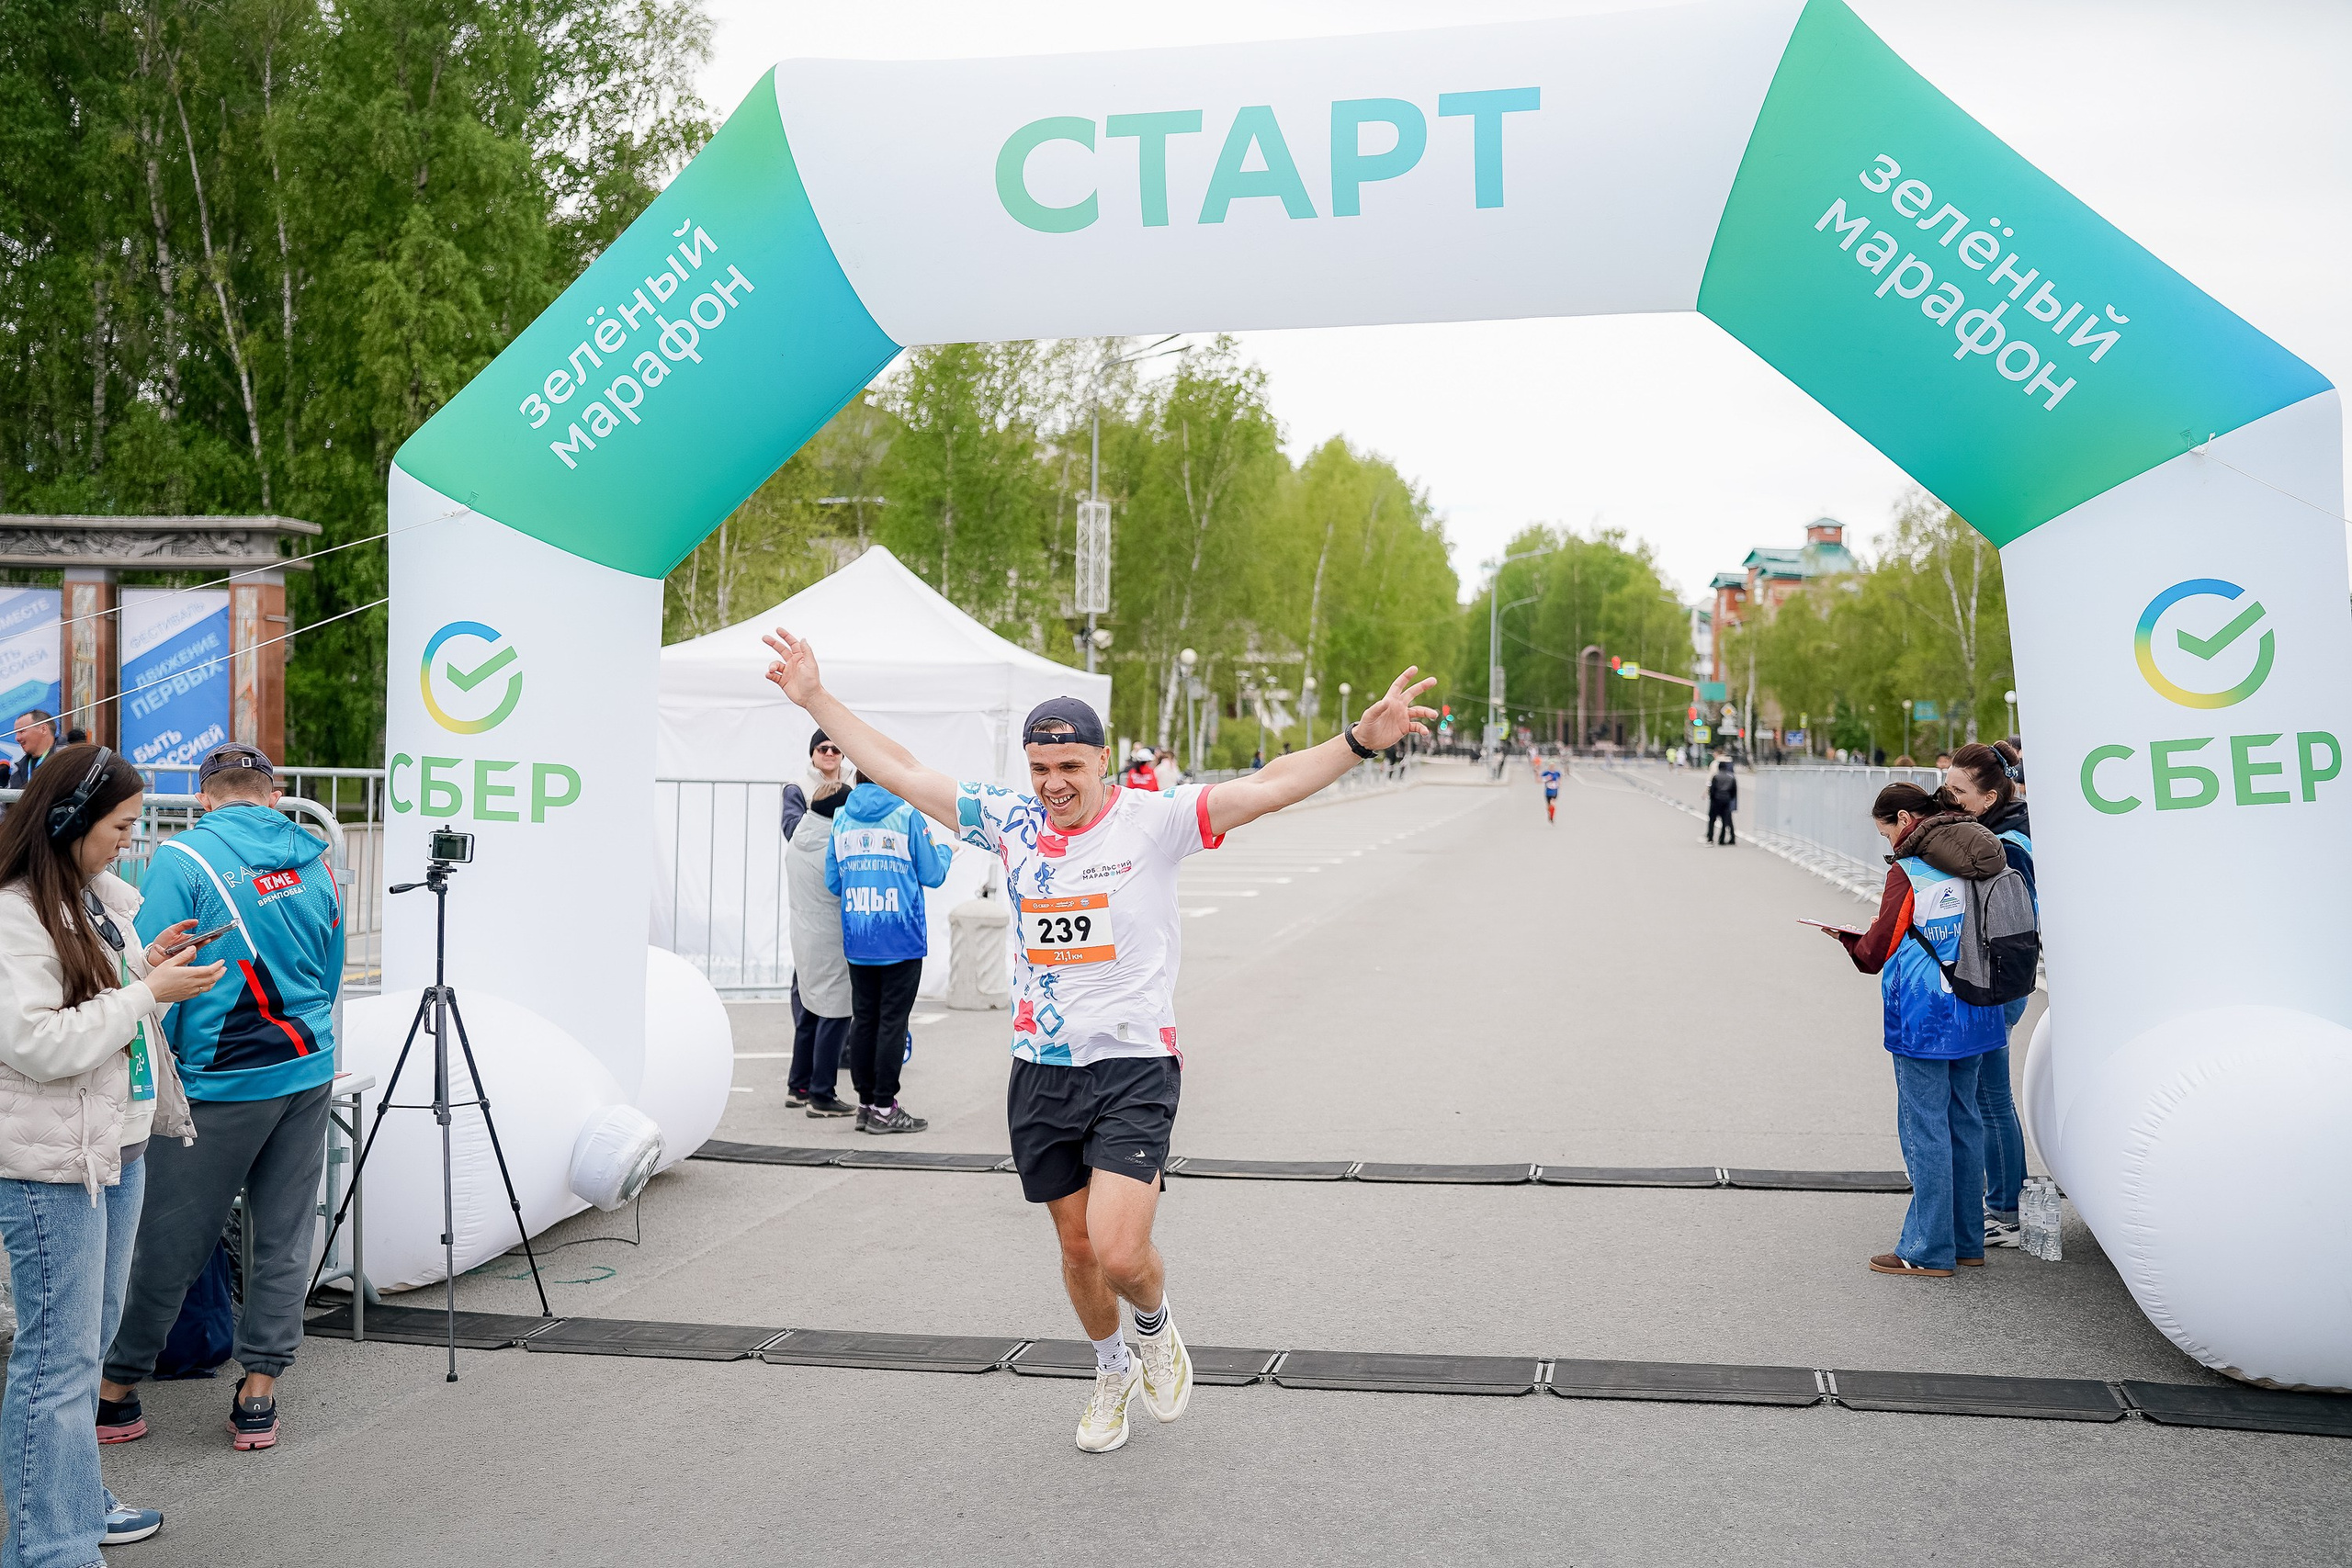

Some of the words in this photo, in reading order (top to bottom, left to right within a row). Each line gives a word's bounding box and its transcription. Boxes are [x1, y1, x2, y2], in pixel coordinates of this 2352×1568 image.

[995, 86, 1541, 233] СТАРТ
[1858, 152, 2131, 364] зелёный
[518, 218, 718, 430] зелёный
[1814, 197, 2078, 412] марафон
[548, 263, 756, 470] марафон
[129, 601, 205, 649] ФЕСТИВАЛЬ
[130, 653, 225, 720] ПЕРВЫХ
[134, 631, 221, 692] ДВИЖЕНИЕ
[132, 728, 183, 764] БЫТЬ
[153, 722, 226, 774] ОССИЕЙ
[2080, 731, 2343, 815] СБЕР
[390, 753, 582, 823] СБЕР
[845, 886, 899, 916] СУДЬЯ
[1082, 870, 1121, 880] МАРАФОН
[1037, 915, 1091, 943] 239
[1054, 951, 1071, 962] 21,1
